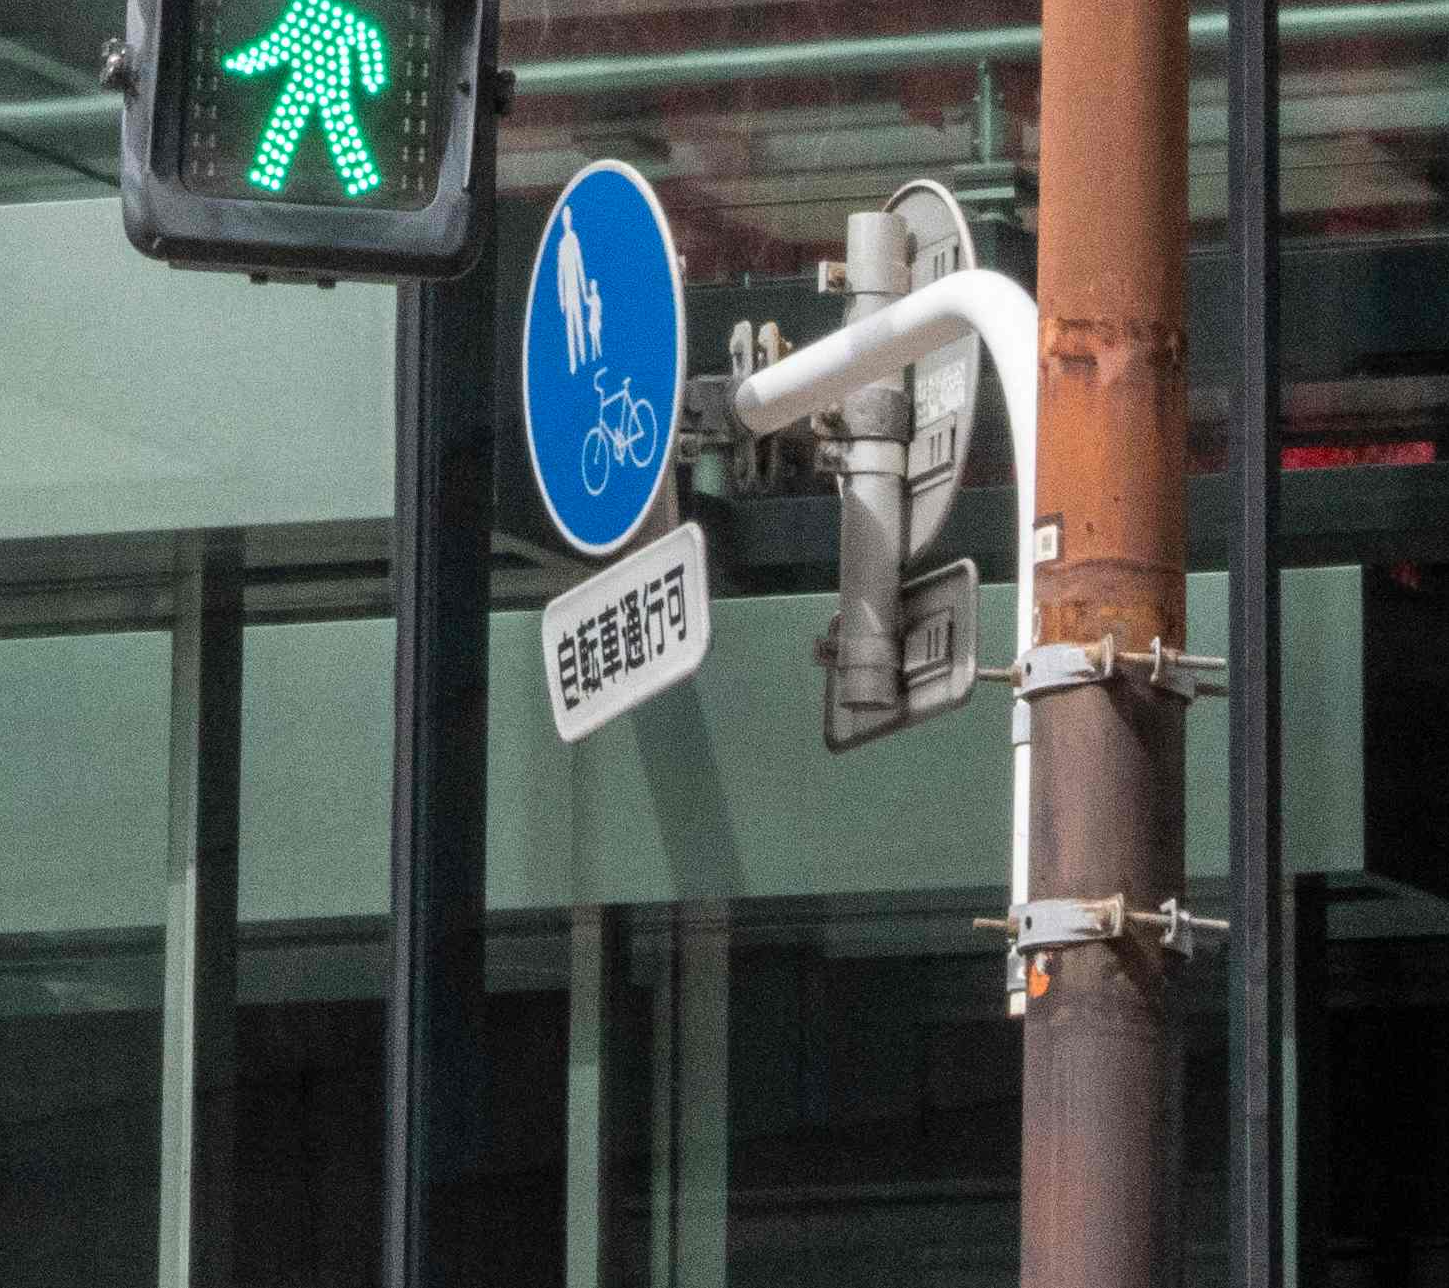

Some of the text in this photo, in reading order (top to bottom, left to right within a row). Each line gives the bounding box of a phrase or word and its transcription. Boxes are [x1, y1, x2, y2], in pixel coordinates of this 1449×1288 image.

[557, 563, 687, 710] 自転車通行可
